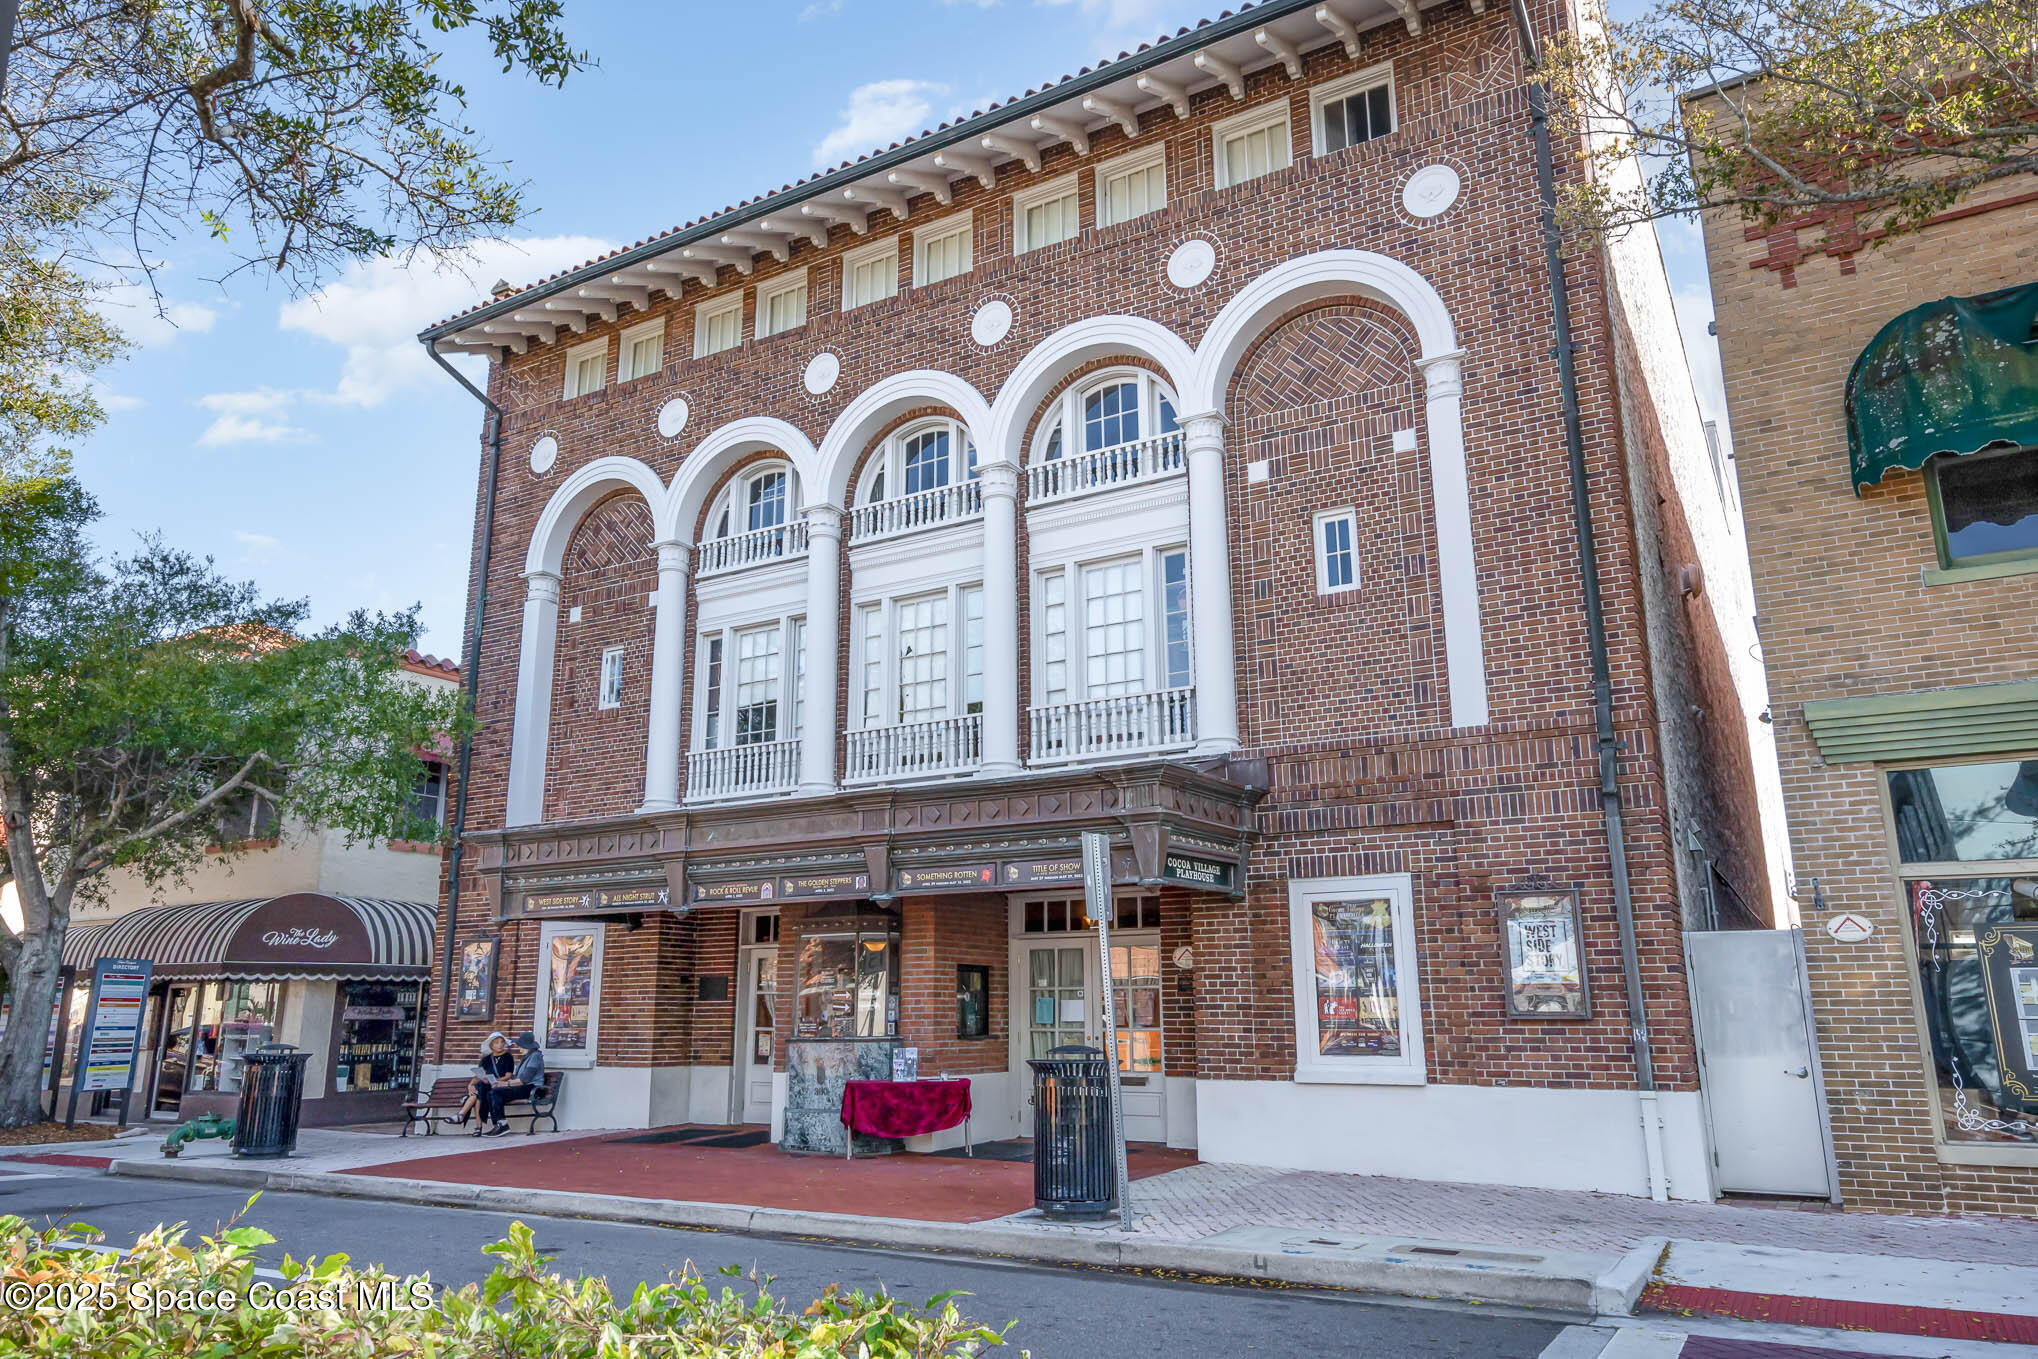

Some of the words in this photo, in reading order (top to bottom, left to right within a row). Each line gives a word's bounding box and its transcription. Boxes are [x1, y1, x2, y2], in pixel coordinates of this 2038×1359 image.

[1032, 864, 1047, 873] TITLE
[1048, 864, 1059, 872] OF
[1059, 862, 1081, 871] SHOW
[1167, 857, 1191, 870] COCOA
[1193, 861, 1221, 875] VILLAGE
[807, 878, 829, 886] GOLDEN
[829, 876, 852, 885] STEPPERS
[916, 871, 953, 881] SOMETHING
[953, 870, 978, 879] ROTTEN
[1176, 868, 1215, 883] PLAYHOUSE
[709, 887, 724, 895] ROCK
[729, 886, 742, 894] ROLL
[742, 885, 759, 893] REVUE
[552, 897, 563, 905] SIDE
[563, 896, 579, 904] STORY
[612, 894, 622, 902] ALL
[622, 892, 639, 901] NIGHT
[639, 892, 655, 900] STRUT
[289, 927, 305, 937] The
[1524, 924, 1557, 938] WEST
[262, 931, 300, 946] Wine
[300, 927, 340, 949] Lady
[1526, 939, 1552, 953] SIDE
[1528, 953, 1563, 968] STORY
